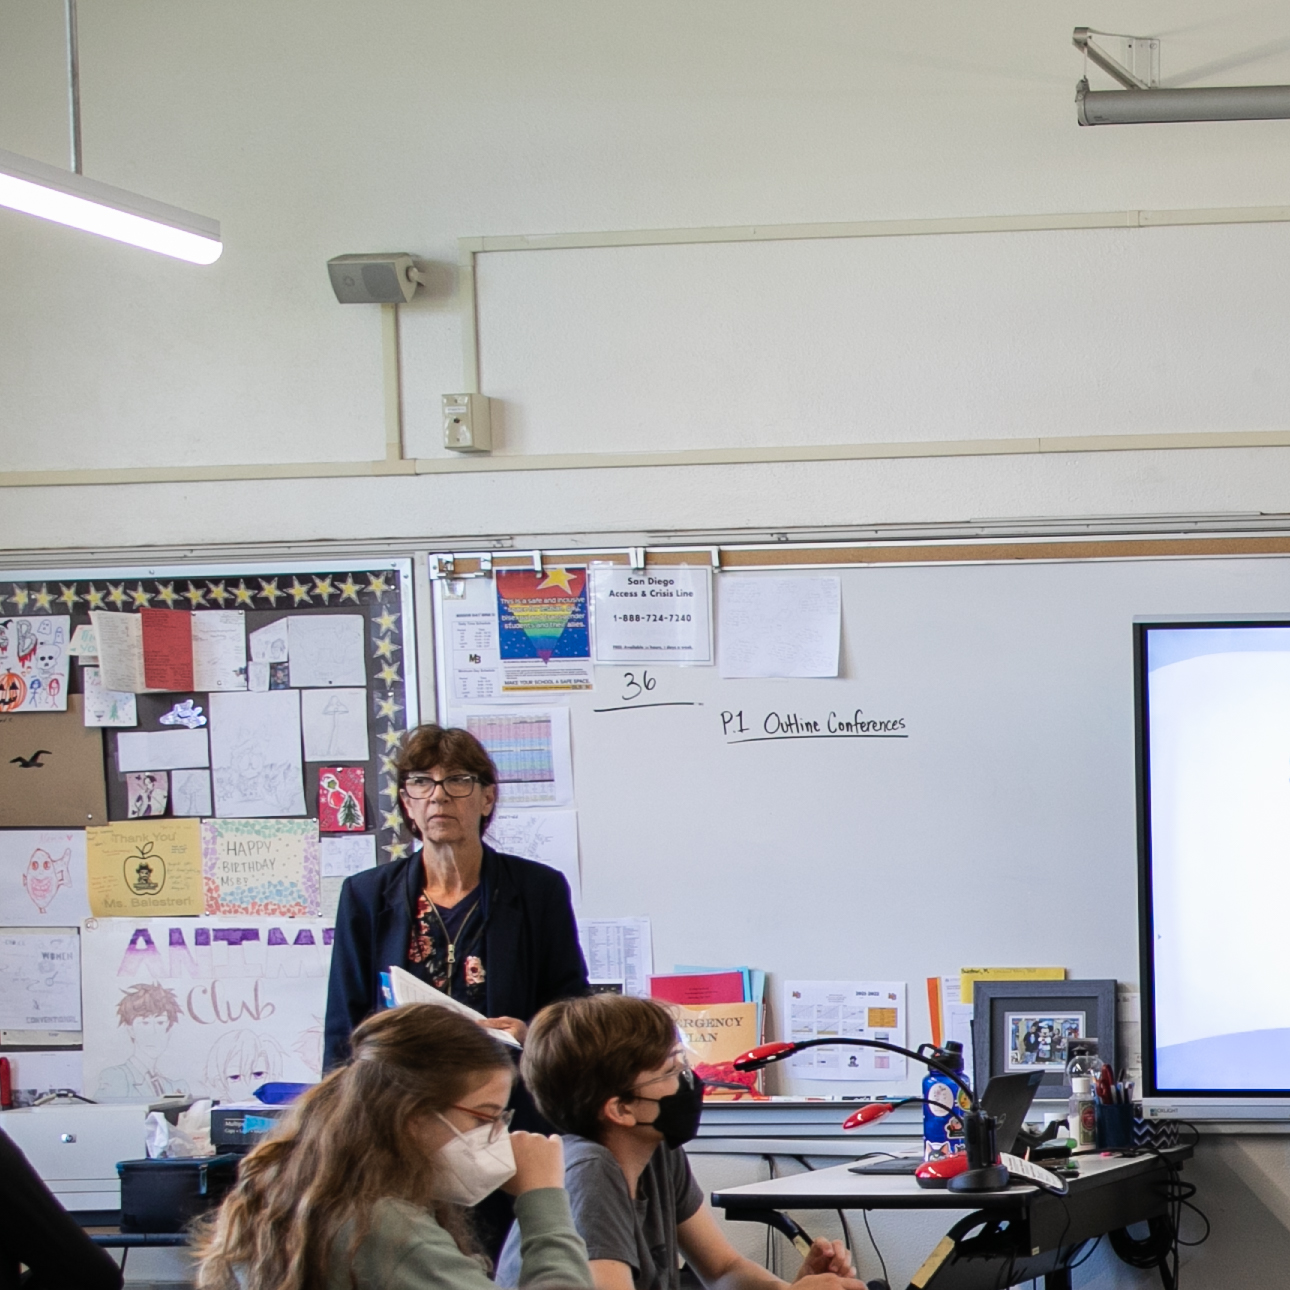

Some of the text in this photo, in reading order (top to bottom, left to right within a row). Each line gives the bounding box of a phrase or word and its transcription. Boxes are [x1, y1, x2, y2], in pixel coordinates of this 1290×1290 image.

[628, 577, 674, 587] San Diego
[650, 589, 674, 597] Crisis
[676, 589, 694, 597] Line
[613, 614, 692, 622] 1-888-724-7240
[622, 670, 656, 700] 36
[764, 712, 820, 734] Outline
[828, 709, 906, 734] Conferences
[226, 840, 272, 856] HAPPY
[222, 858, 276, 873] BIRTHDAY
[187, 980, 275, 1024] Club
[687, 1033, 718, 1042] LAN
